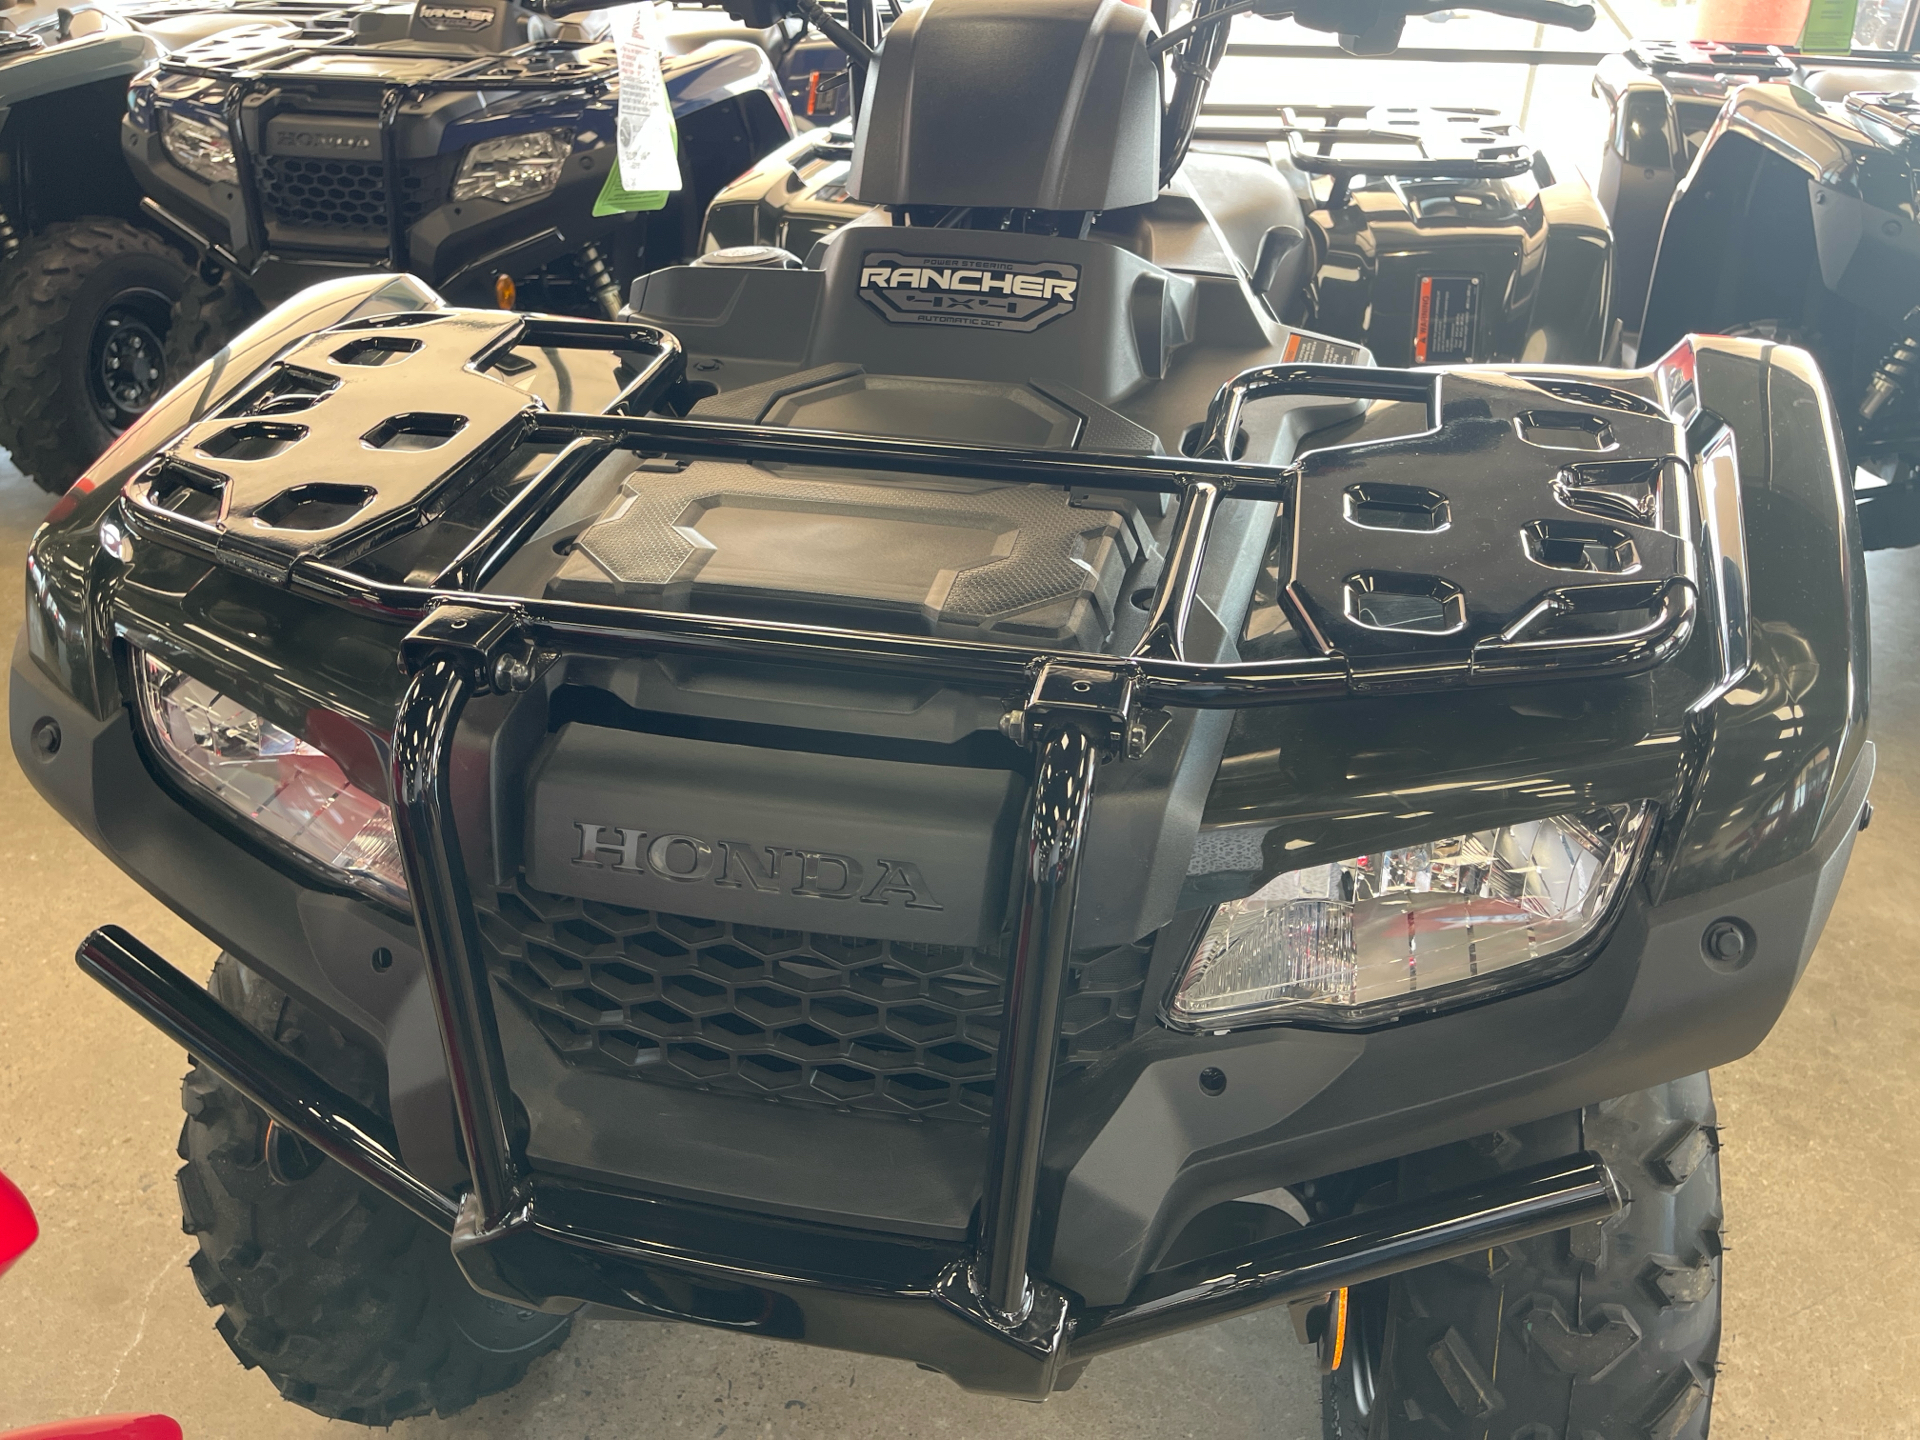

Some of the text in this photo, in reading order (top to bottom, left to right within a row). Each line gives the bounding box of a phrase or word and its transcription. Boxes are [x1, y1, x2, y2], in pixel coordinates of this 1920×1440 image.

[420, 5, 495, 23] RANCHER
[276, 131, 373, 152] HONDA
[923, 258, 1014, 270] POWER STEERING
[860, 267, 1077, 302] RANCHER
[917, 314, 1004, 327] AUTOMATIC DCT
[1419, 295, 1431, 334] WARNING
[570, 821, 945, 912] HONDA
